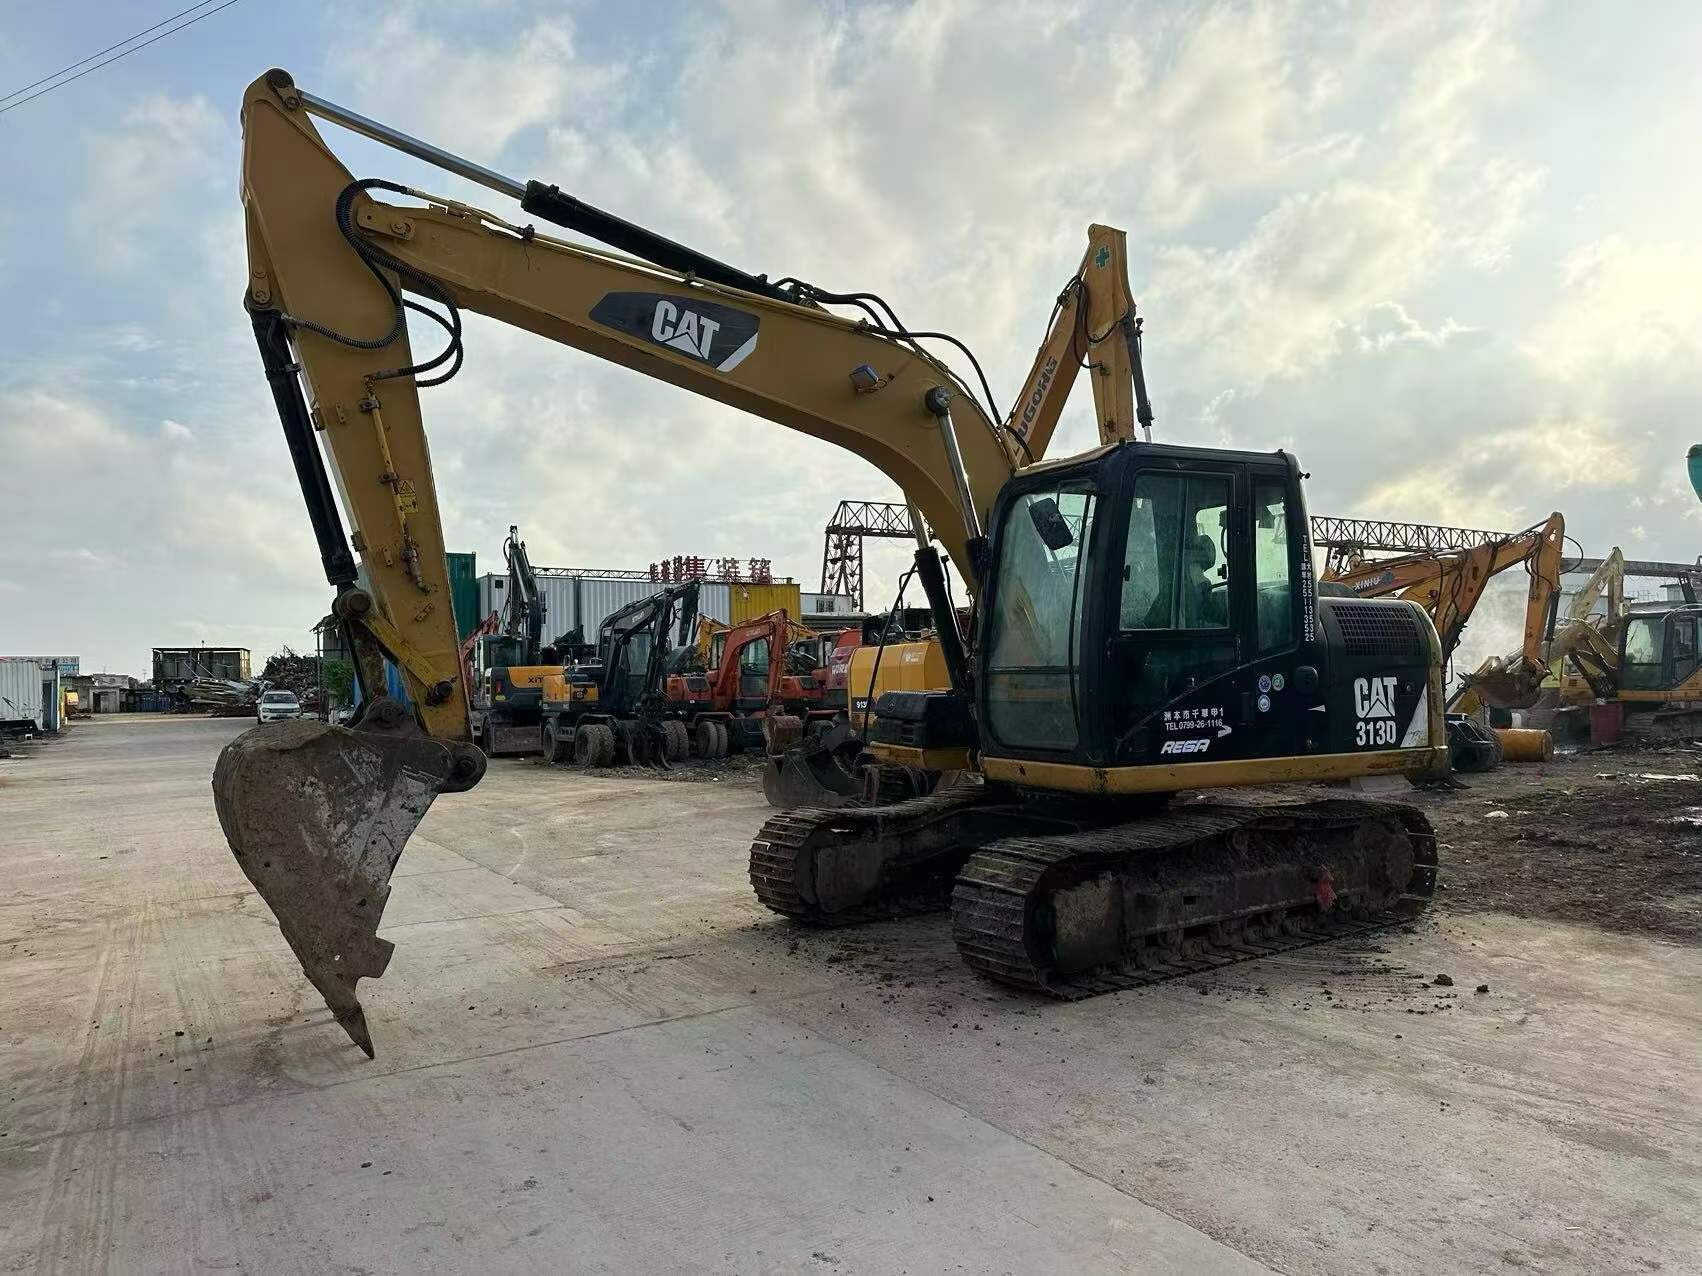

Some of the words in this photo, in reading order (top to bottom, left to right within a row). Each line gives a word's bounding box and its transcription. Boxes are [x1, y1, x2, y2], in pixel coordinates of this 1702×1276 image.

[651, 300, 720, 360] CAT
[1353, 676, 1398, 719] CAT
[1355, 720, 1397, 746] 313D
